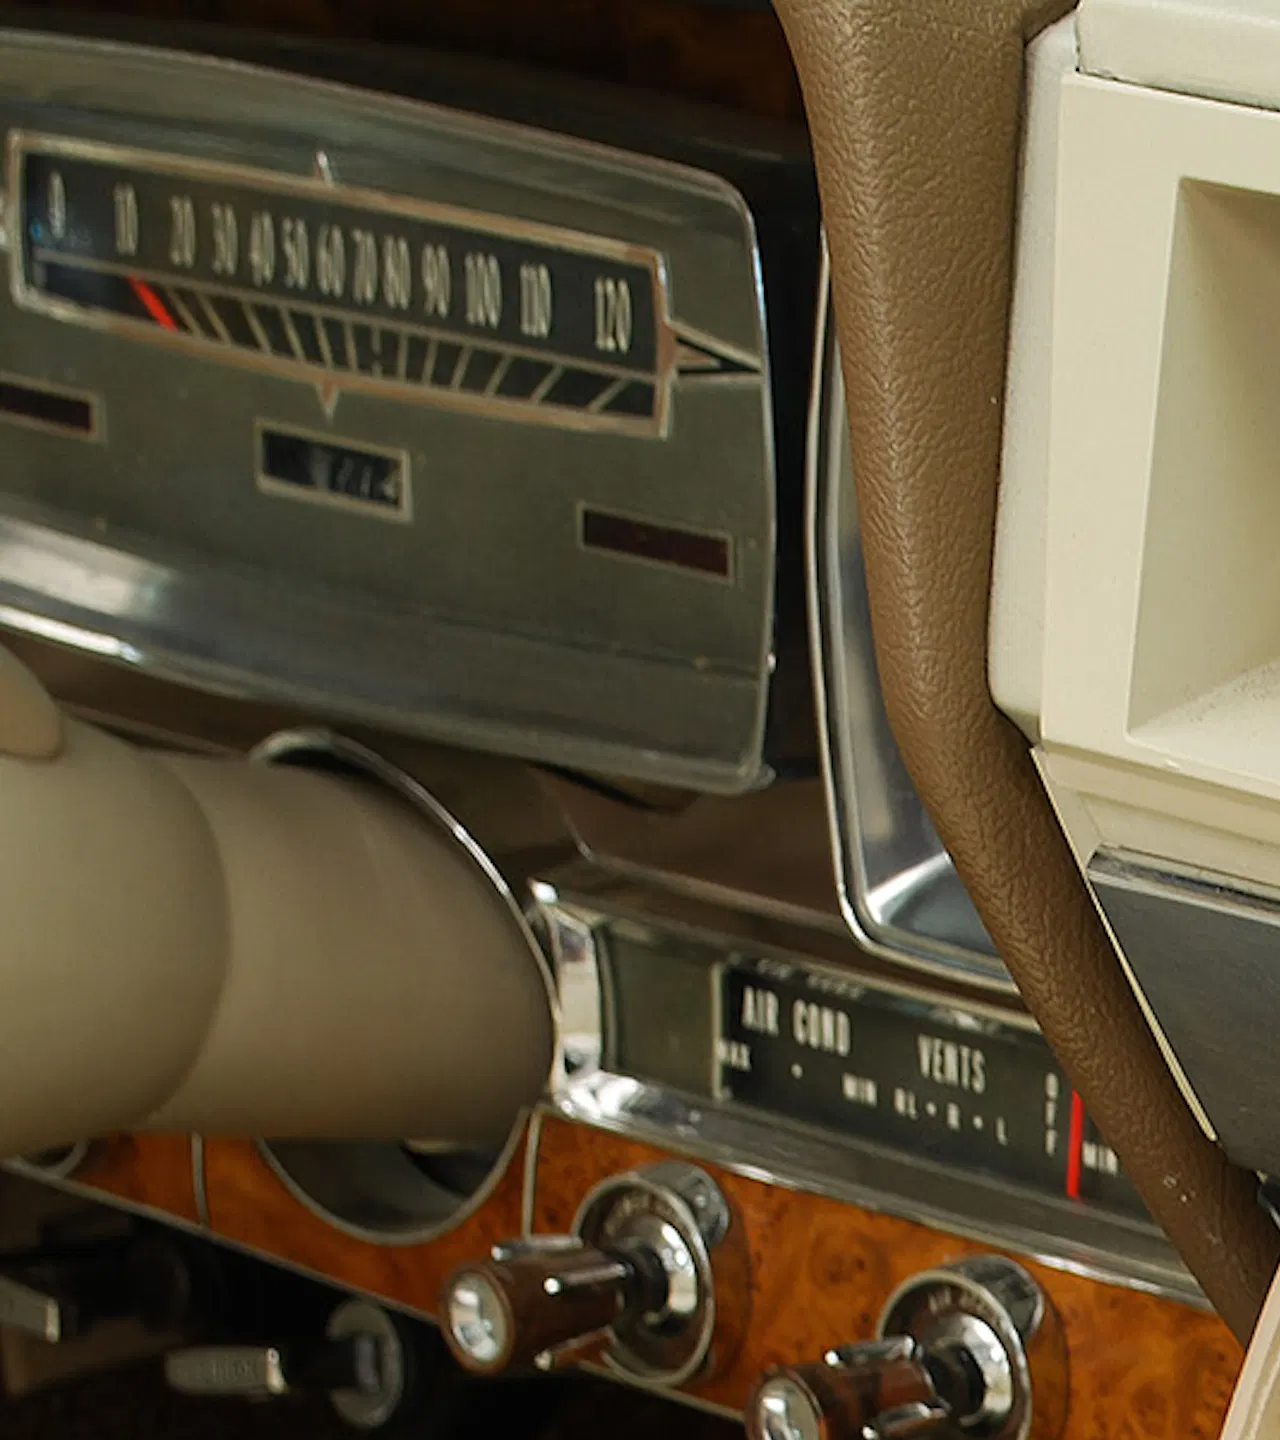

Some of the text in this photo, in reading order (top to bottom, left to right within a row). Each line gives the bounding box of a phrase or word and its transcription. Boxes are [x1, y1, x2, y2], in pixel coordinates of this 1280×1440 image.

[50, 172, 632, 353] 0 10 20 30 40 50 60 70 80 90 100 110 120
[742, 985, 850, 1057] AIR COND
[918, 1033, 986, 1095] VENTS
